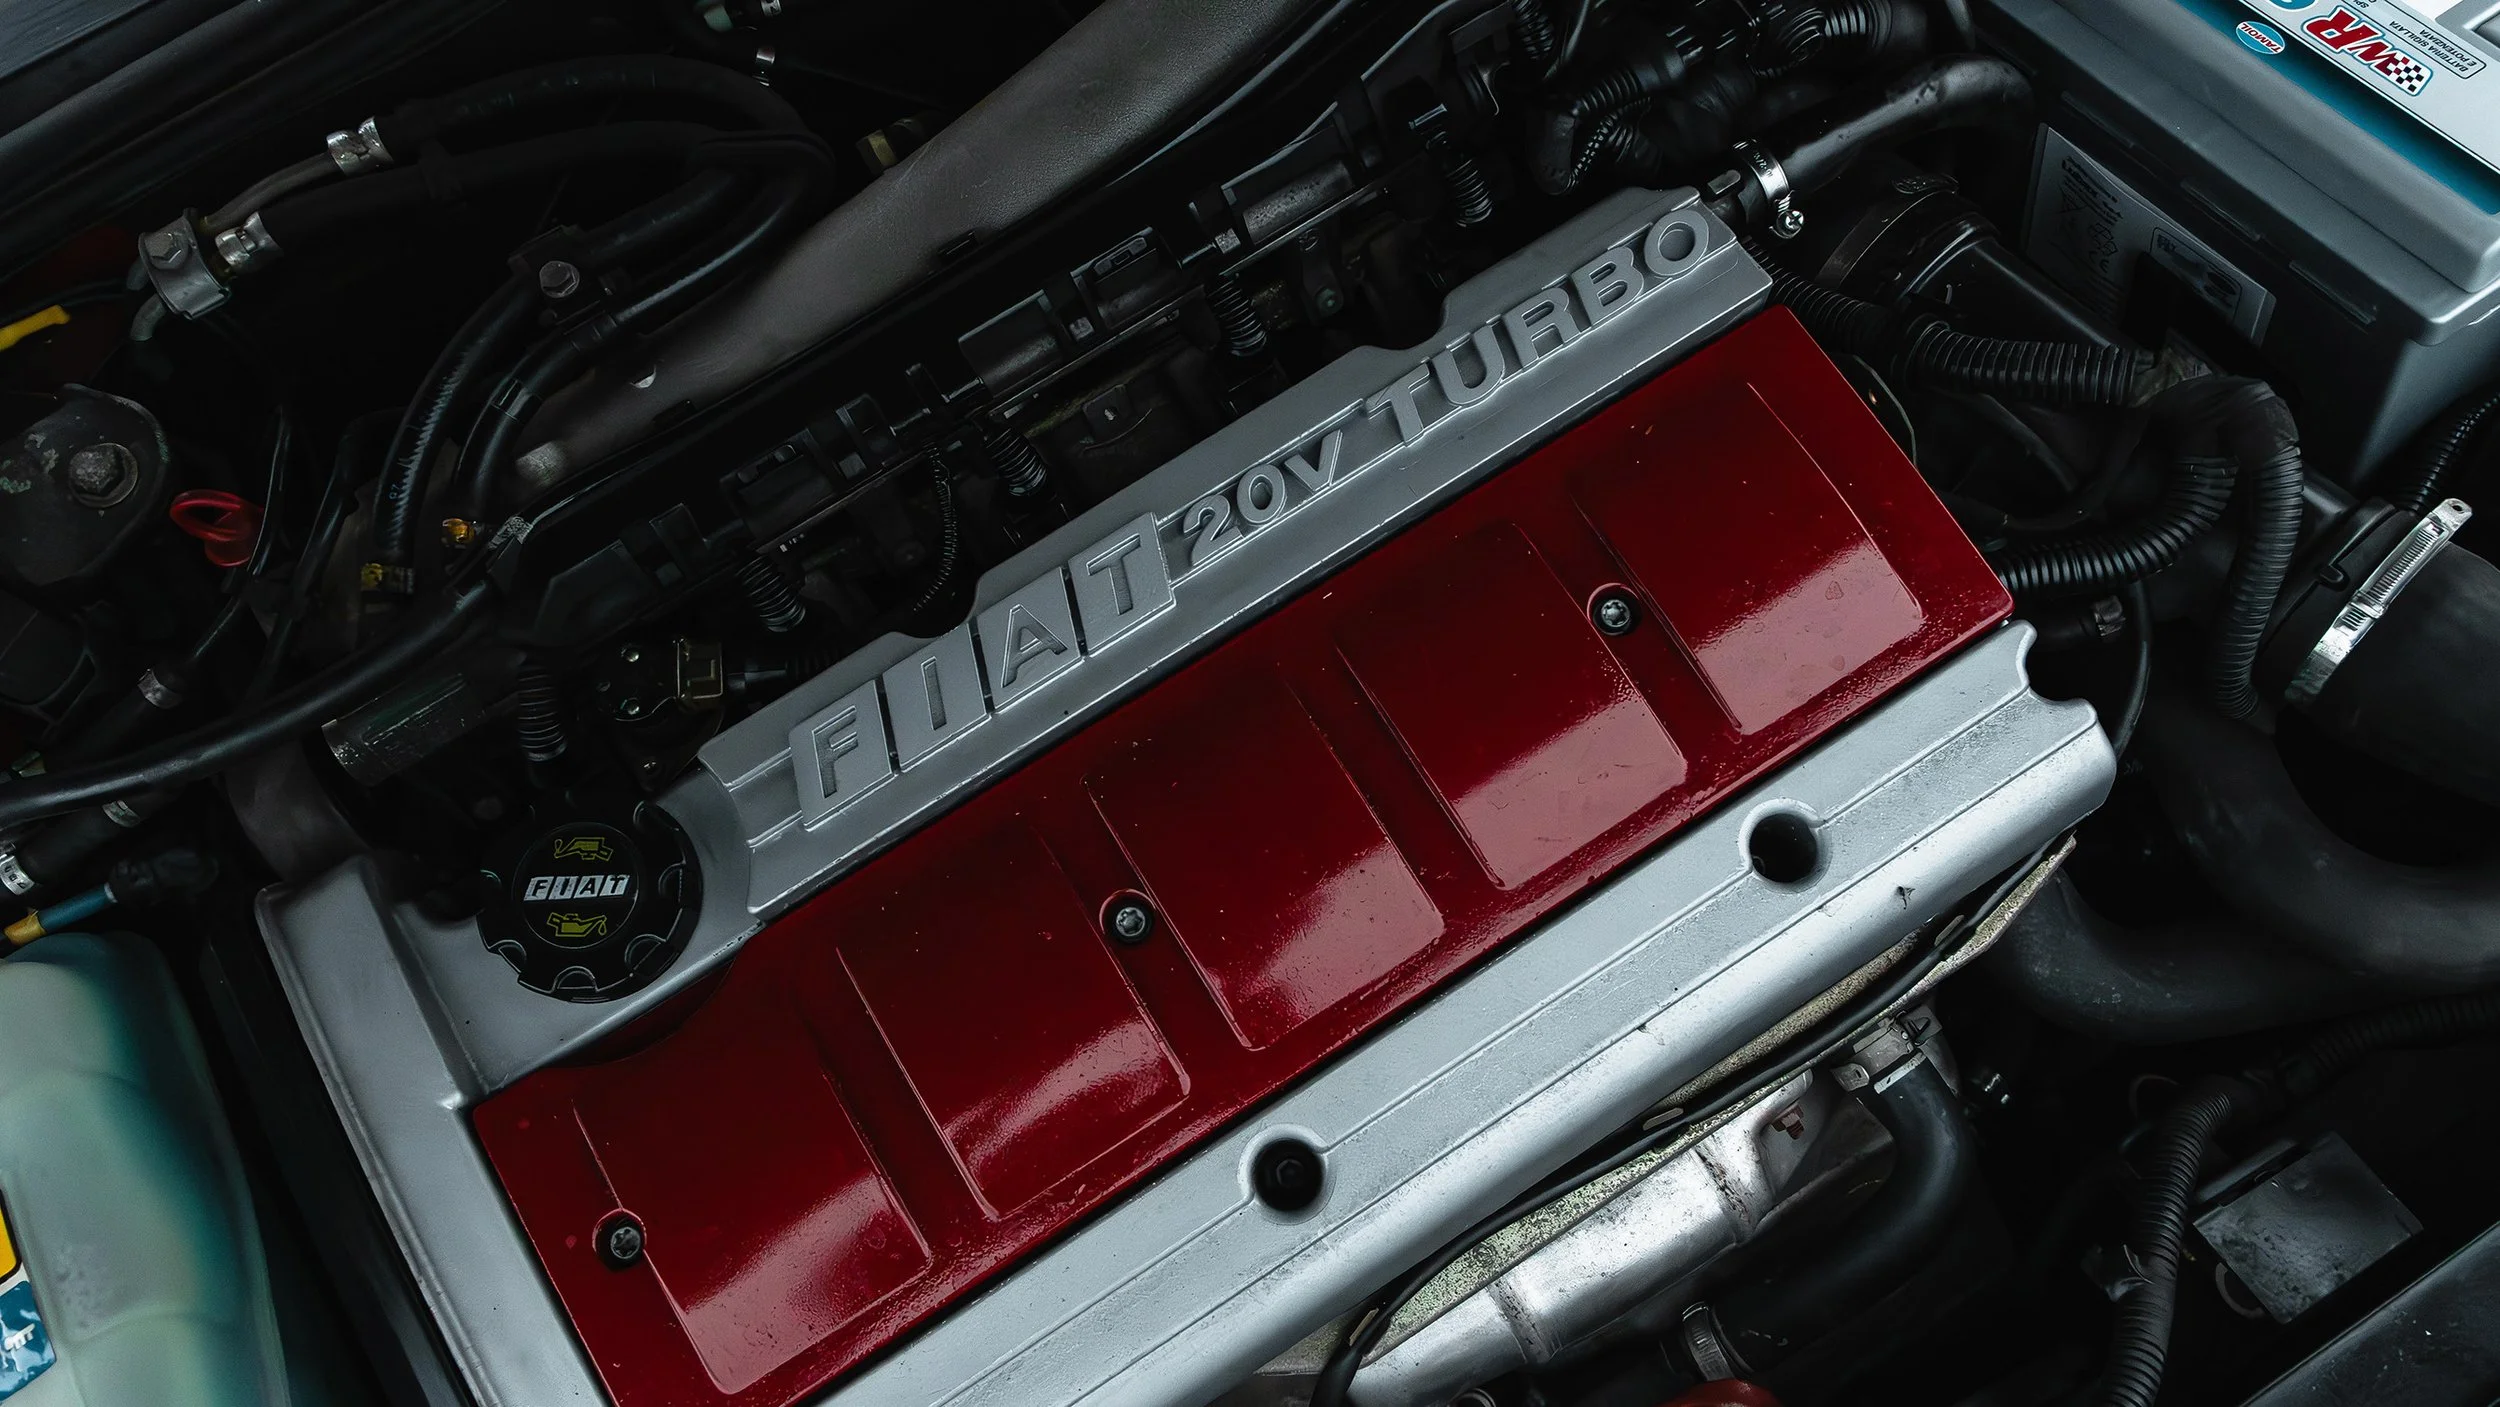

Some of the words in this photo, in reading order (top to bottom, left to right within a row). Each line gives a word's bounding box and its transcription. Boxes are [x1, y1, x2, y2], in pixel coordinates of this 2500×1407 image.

[2239, 21, 2281, 53] TAMOIL
[2389, 20, 2429, 47] SIGILLATA
[2419, 29, 2470, 62] POTENZIATA
[2428, 45, 2469, 72] BATTERIA
[806, 528, 1148, 802] FIAT
[1365, 207, 1710, 447] TURBO
[526, 874, 630, 900] FIAT
